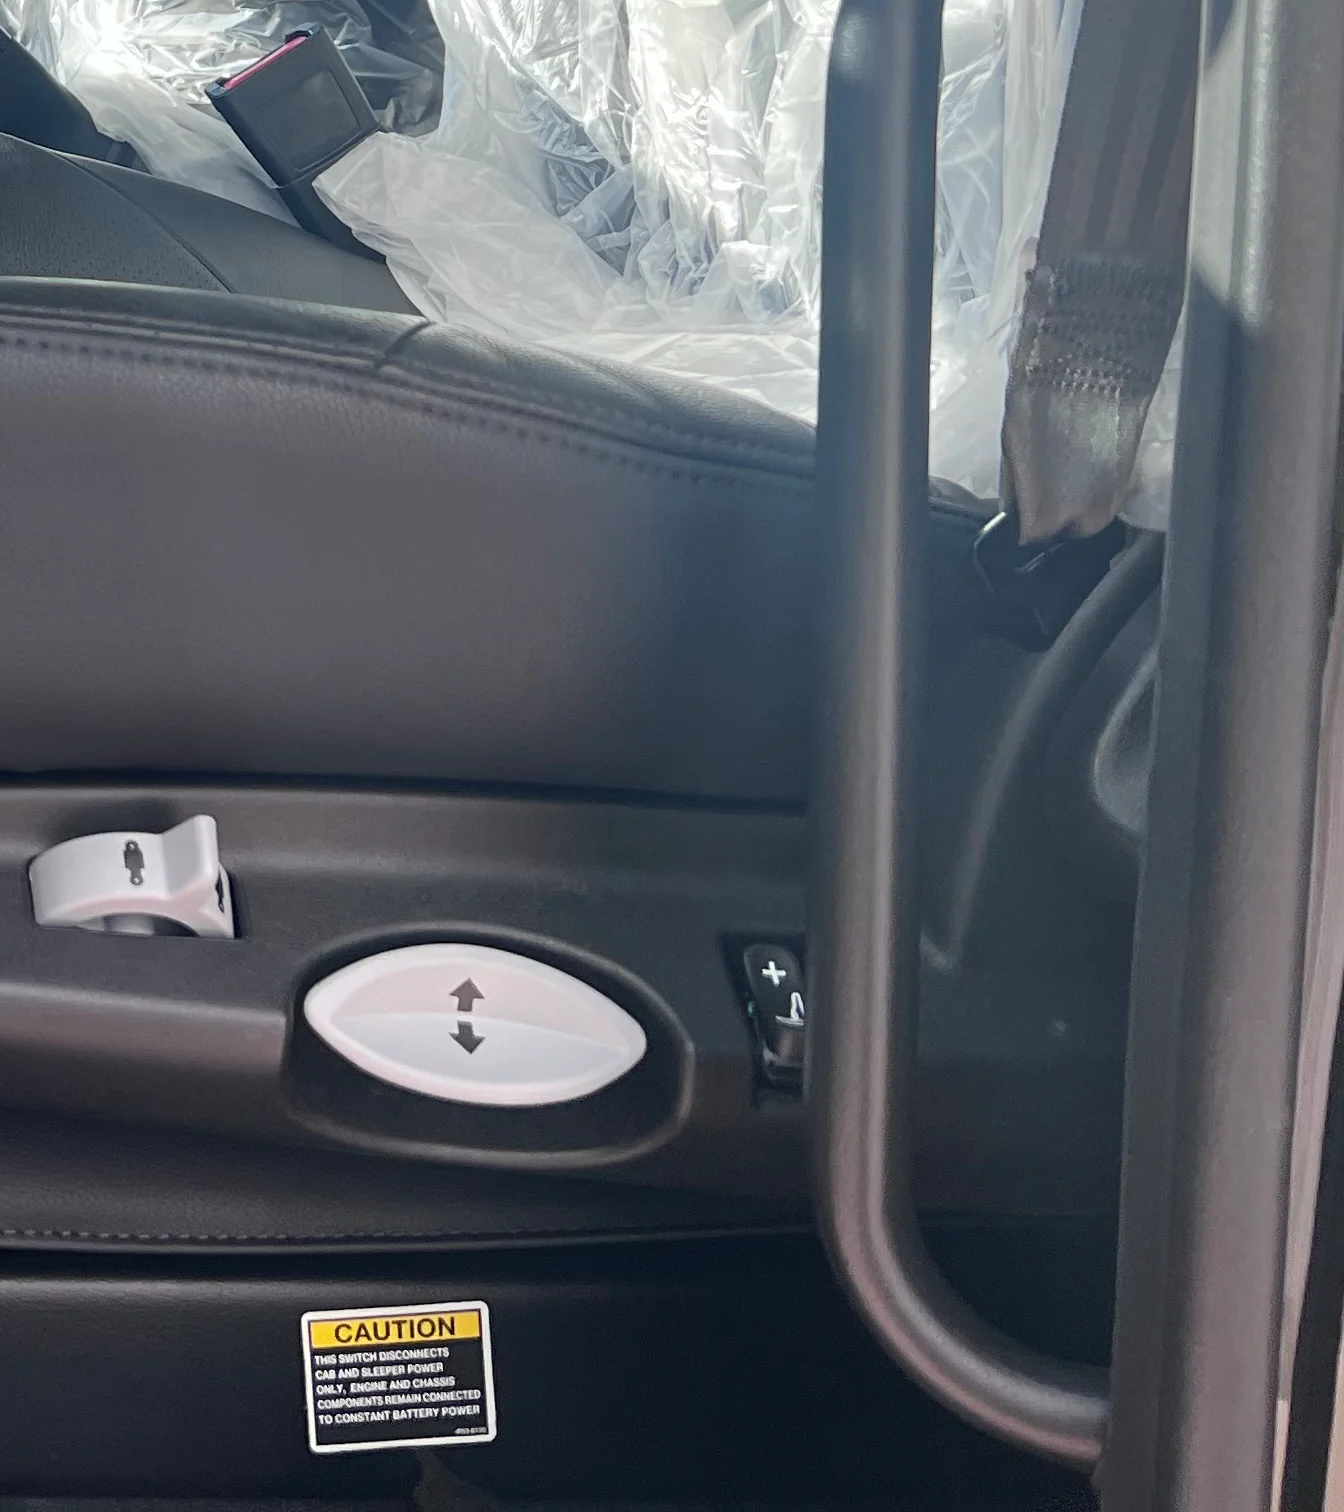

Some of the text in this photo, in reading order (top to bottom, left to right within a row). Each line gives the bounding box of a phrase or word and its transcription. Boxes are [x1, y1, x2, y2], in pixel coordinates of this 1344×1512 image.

[334, 1316, 456, 1343] CAUTION
[314, 1347, 450, 1366] THIS SWITCH DISCONNECTS
[315, 1362, 444, 1380] CAB AND SLEEPER POWER
[350, 1381, 387, 1393] ENGINE
[389, 1379, 411, 1390] AND
[413, 1376, 455, 1388] CHASSIS
[317, 1390, 481, 1410] COMPONENTS REMAIN CONNECTED
[318, 1405, 480, 1424] TO CONSTANT BATTERY POWER
